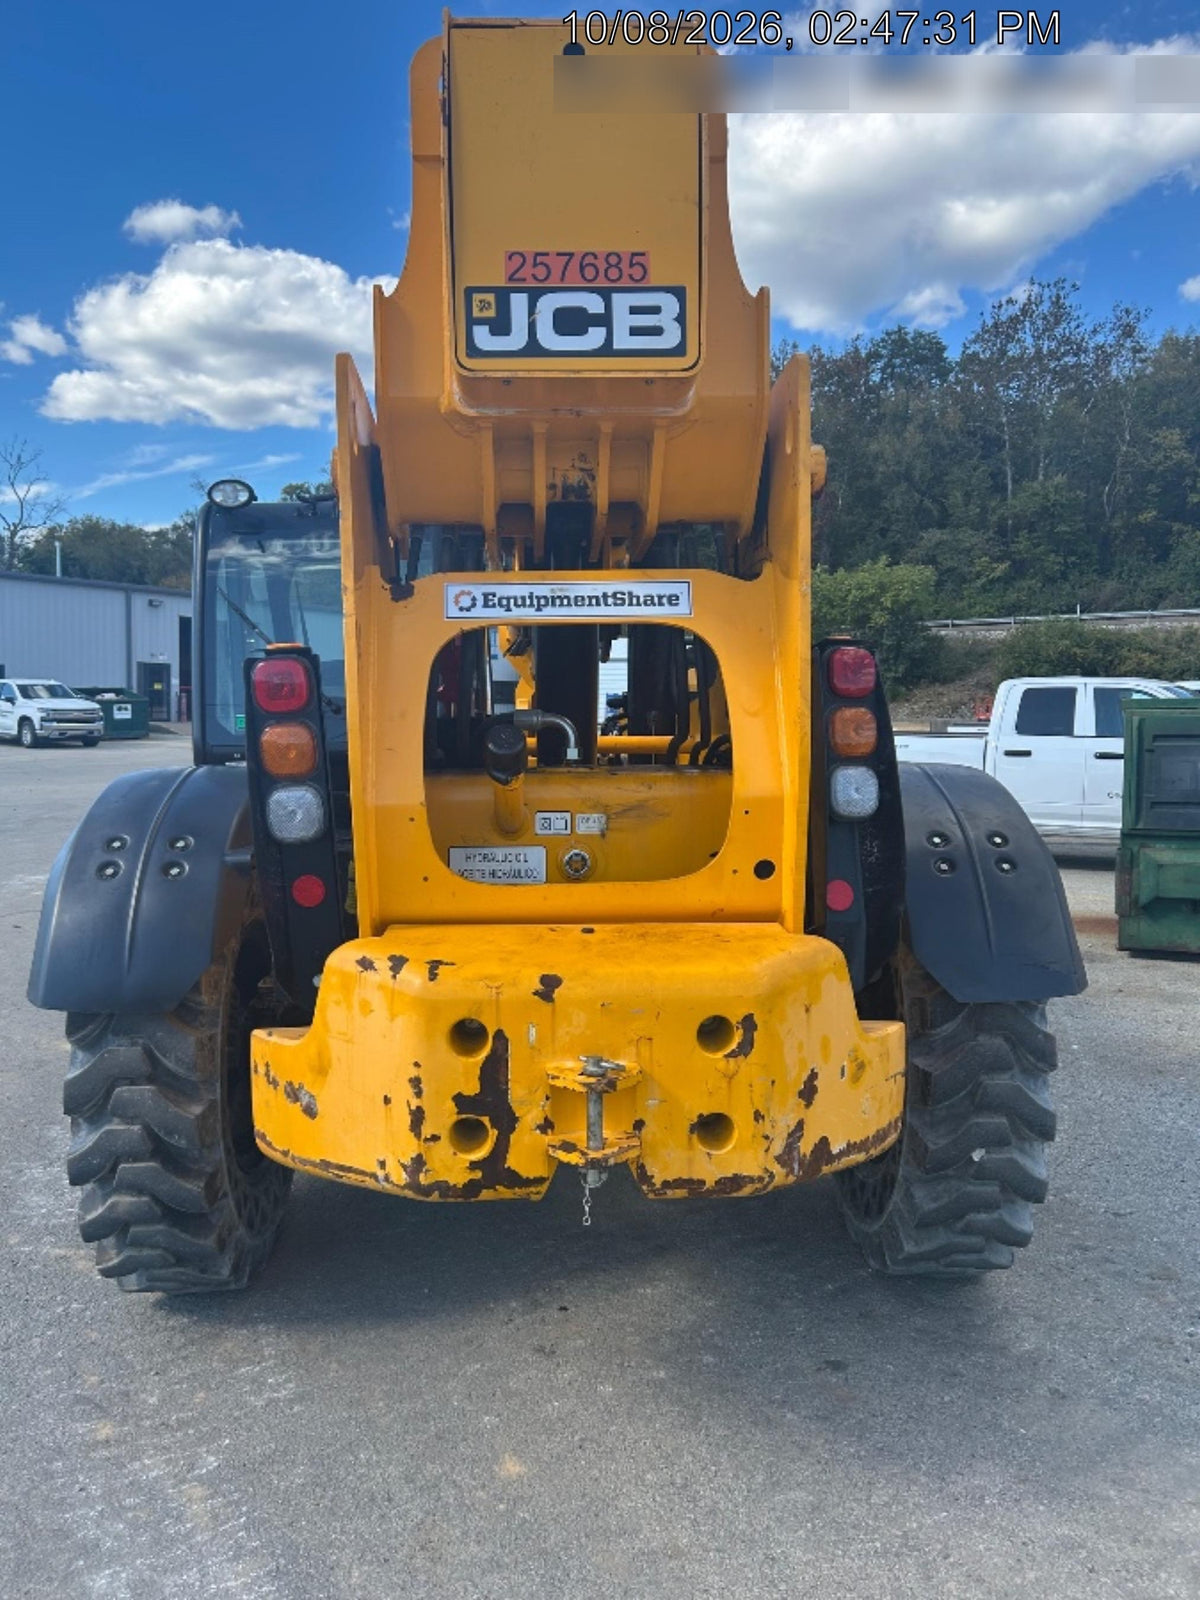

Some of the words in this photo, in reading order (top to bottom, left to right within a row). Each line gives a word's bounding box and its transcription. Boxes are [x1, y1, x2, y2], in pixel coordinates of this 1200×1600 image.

[507, 252, 648, 283] 257685
[472, 291, 682, 351] JCB
[481, 591, 681, 612] EquipmentShare
